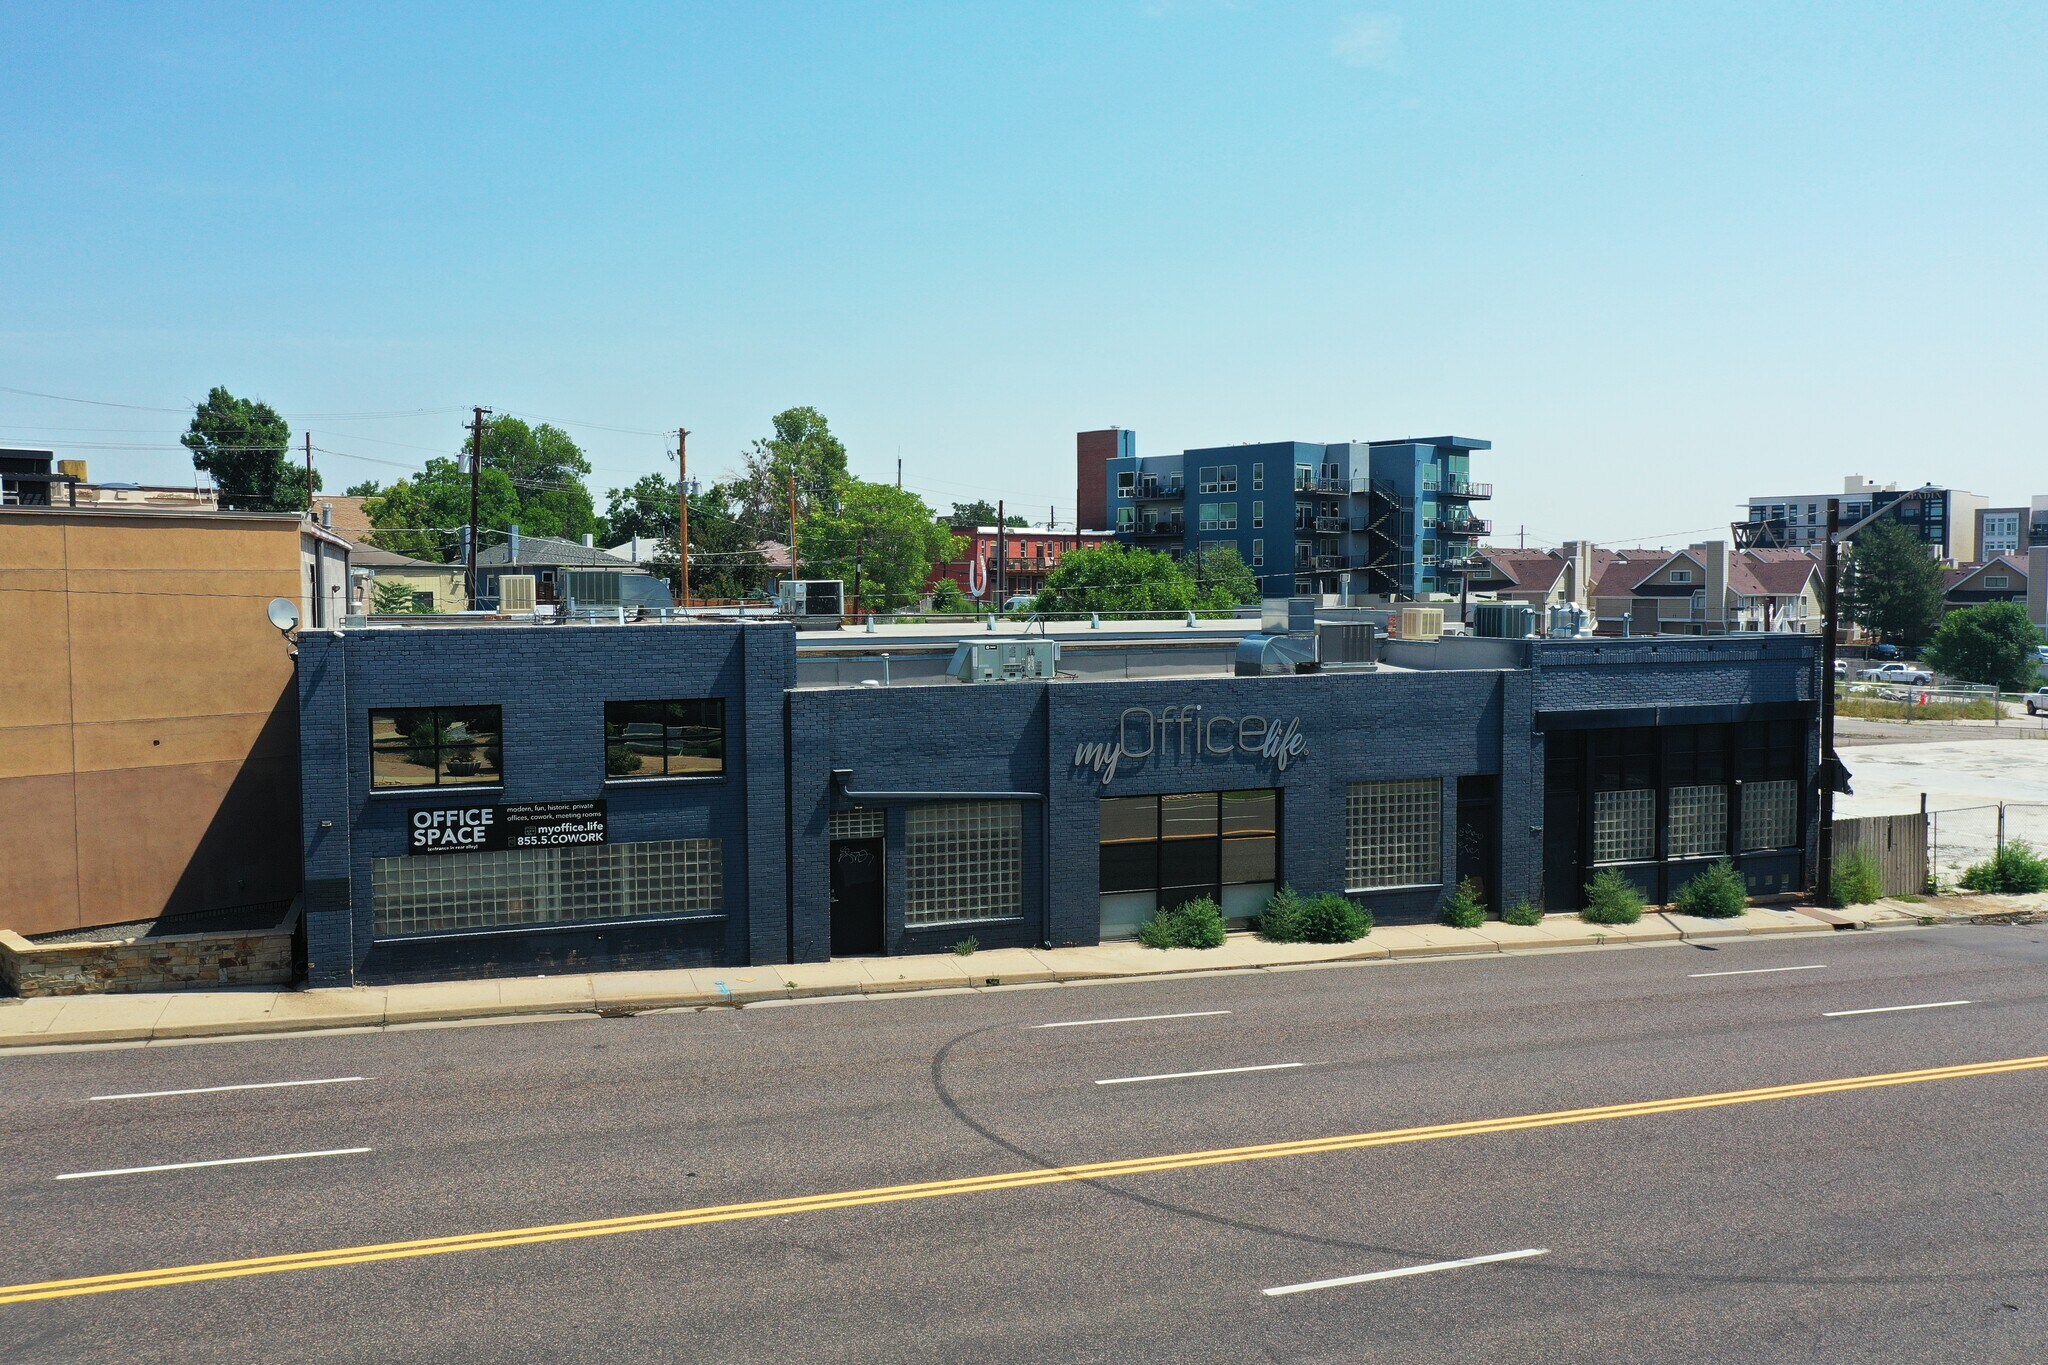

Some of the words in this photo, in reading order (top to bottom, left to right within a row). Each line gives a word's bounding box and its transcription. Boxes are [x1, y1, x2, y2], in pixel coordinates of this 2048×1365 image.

[413, 809, 493, 828] OFFICE
[555, 812, 581, 820] meeting
[538, 821, 603, 835] myoffice.life
[413, 826, 486, 846] SPACE
[517, 832, 604, 846] 855.5.COWORK
